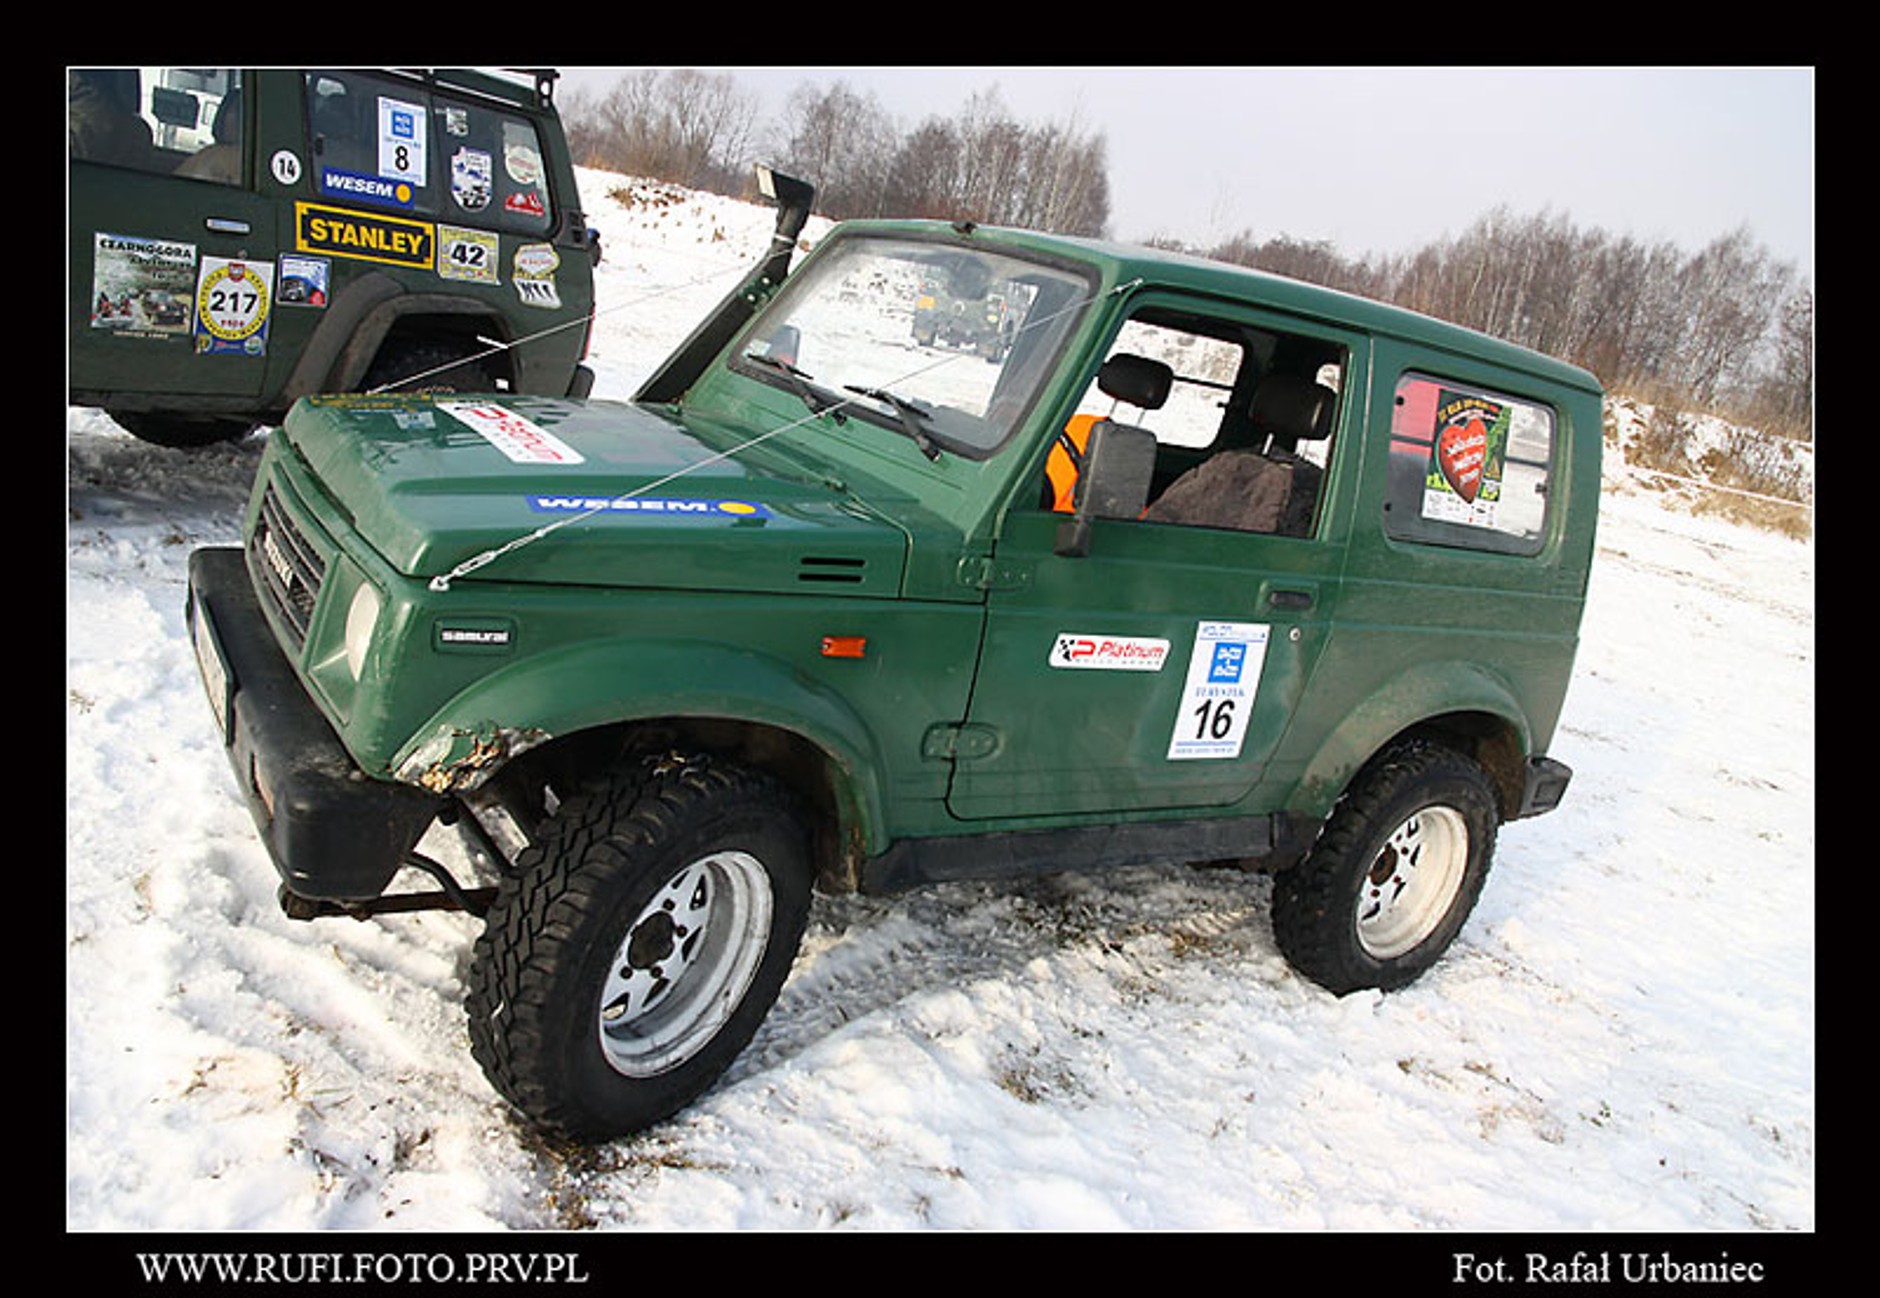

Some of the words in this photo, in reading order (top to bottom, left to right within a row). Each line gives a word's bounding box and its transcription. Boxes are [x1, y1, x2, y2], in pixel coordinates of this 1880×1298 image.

[278, 158, 296, 178] 14
[394, 145, 409, 172] 8
[326, 173, 394, 198] WESEM
[310, 218, 424, 255] STANLEY
[451, 244, 486, 267] 42
[210, 290, 258, 314] 217
[1098, 640, 1164, 658] Platinum
[1194, 698, 1236, 740] 16
